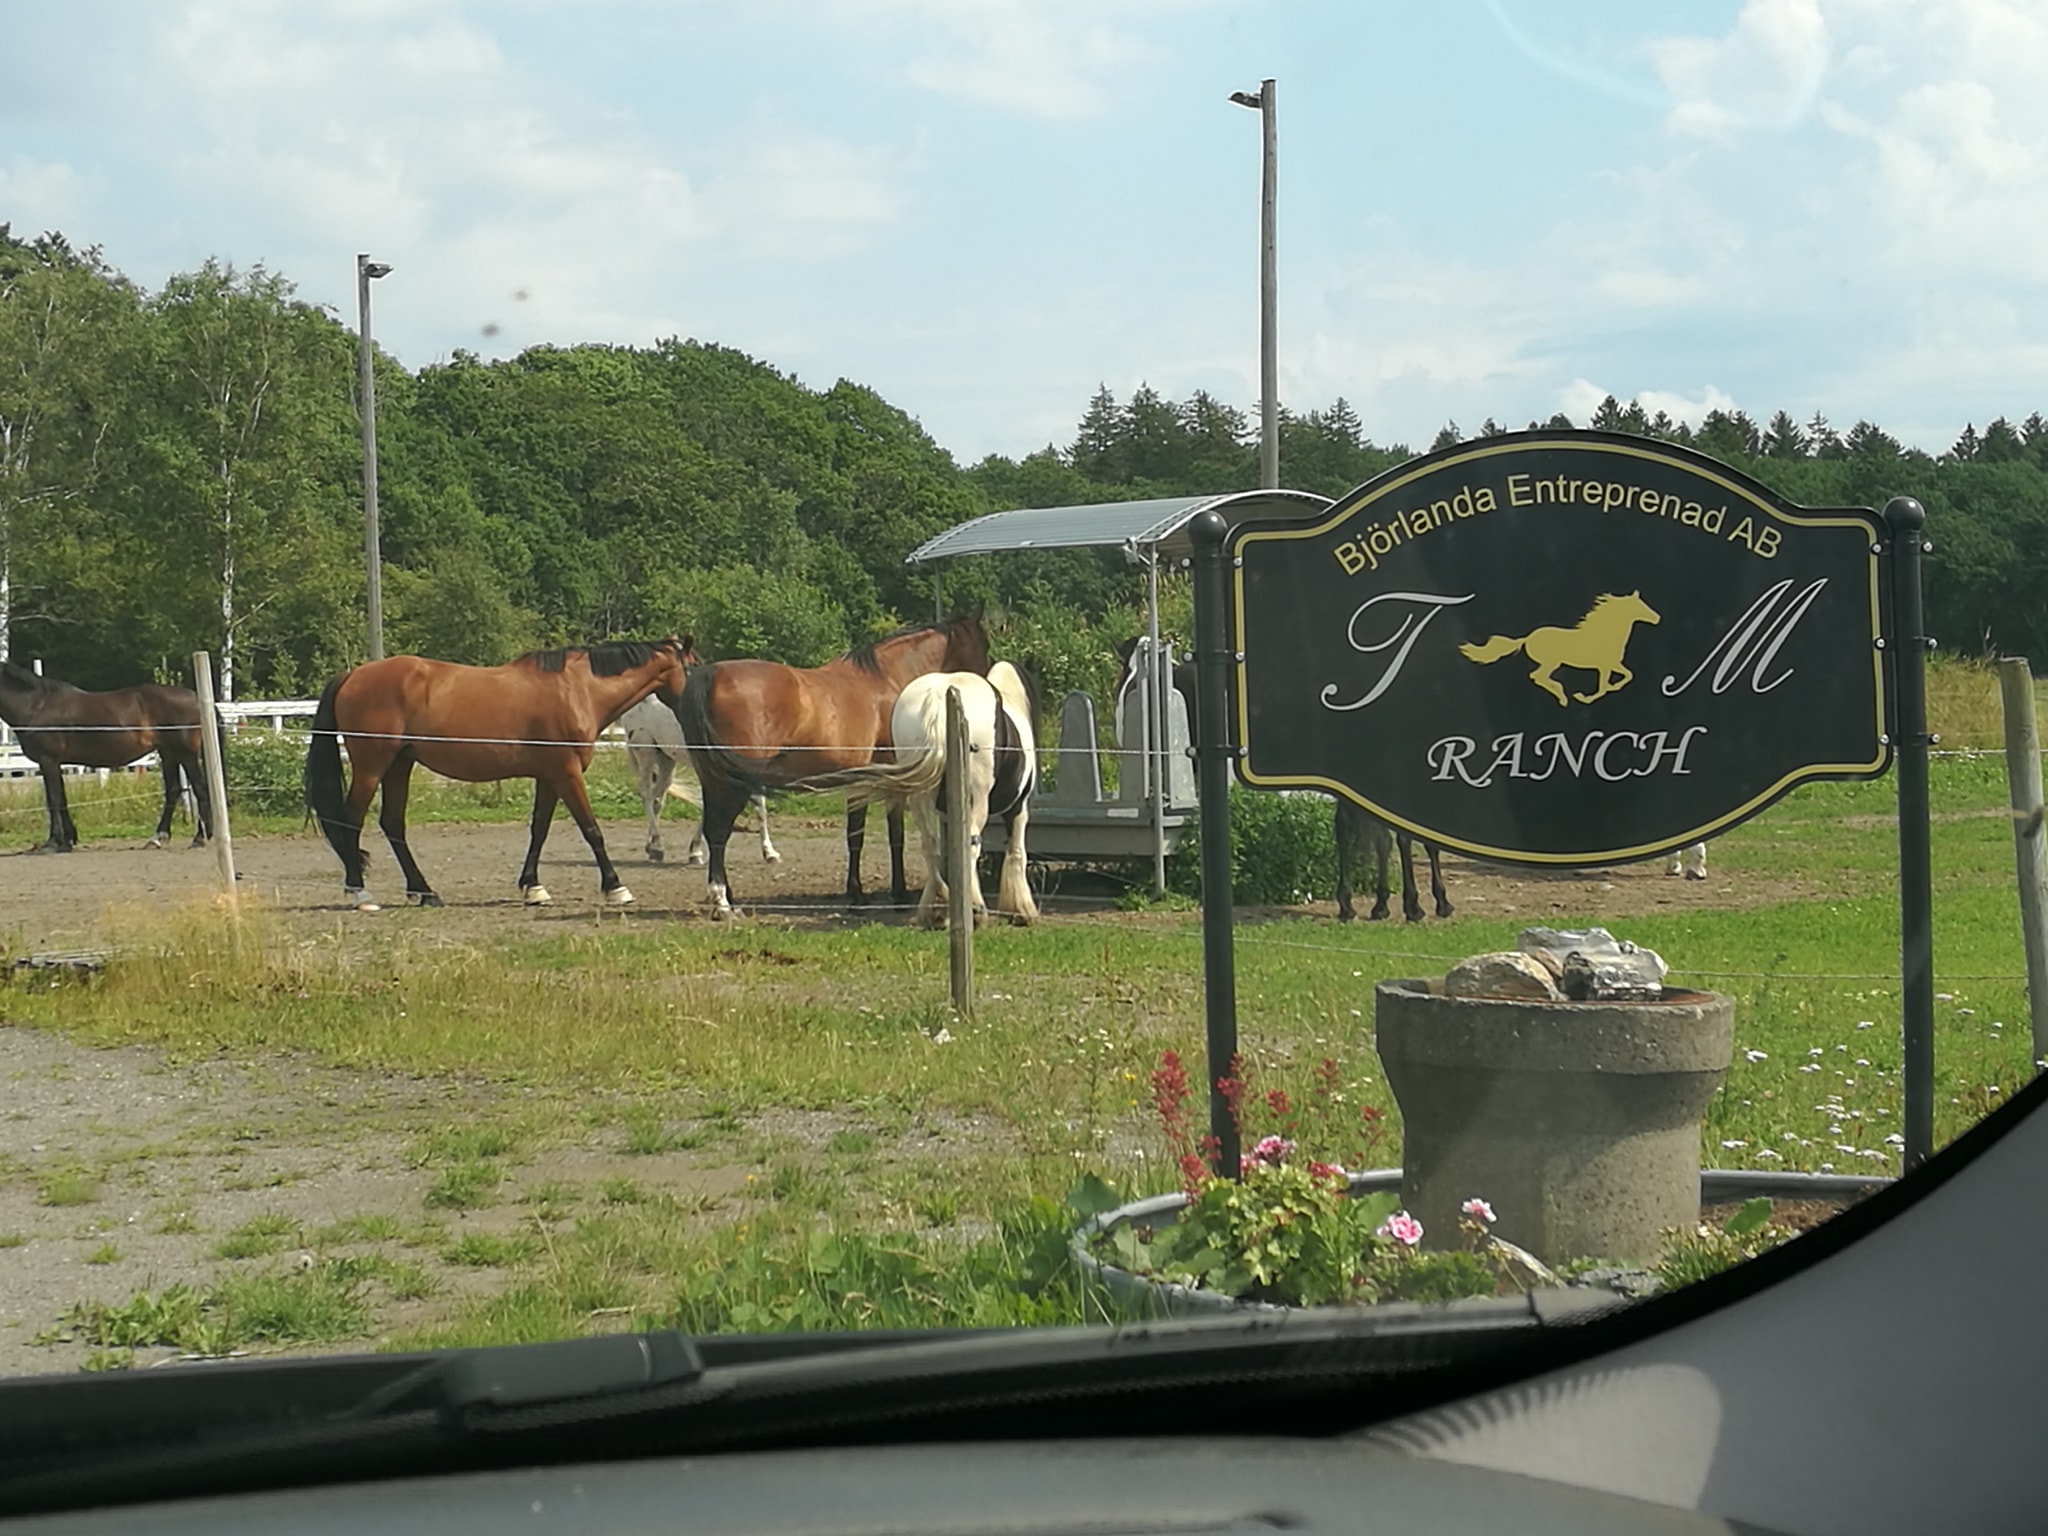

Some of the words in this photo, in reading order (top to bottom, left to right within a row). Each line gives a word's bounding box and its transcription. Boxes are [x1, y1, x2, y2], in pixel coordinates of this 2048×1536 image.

[1333, 485, 1498, 576] Björlanda
[1507, 473, 1728, 535] Entreprenad
[1727, 516, 1784, 560] AB
[1427, 726, 1708, 789] RANCH
